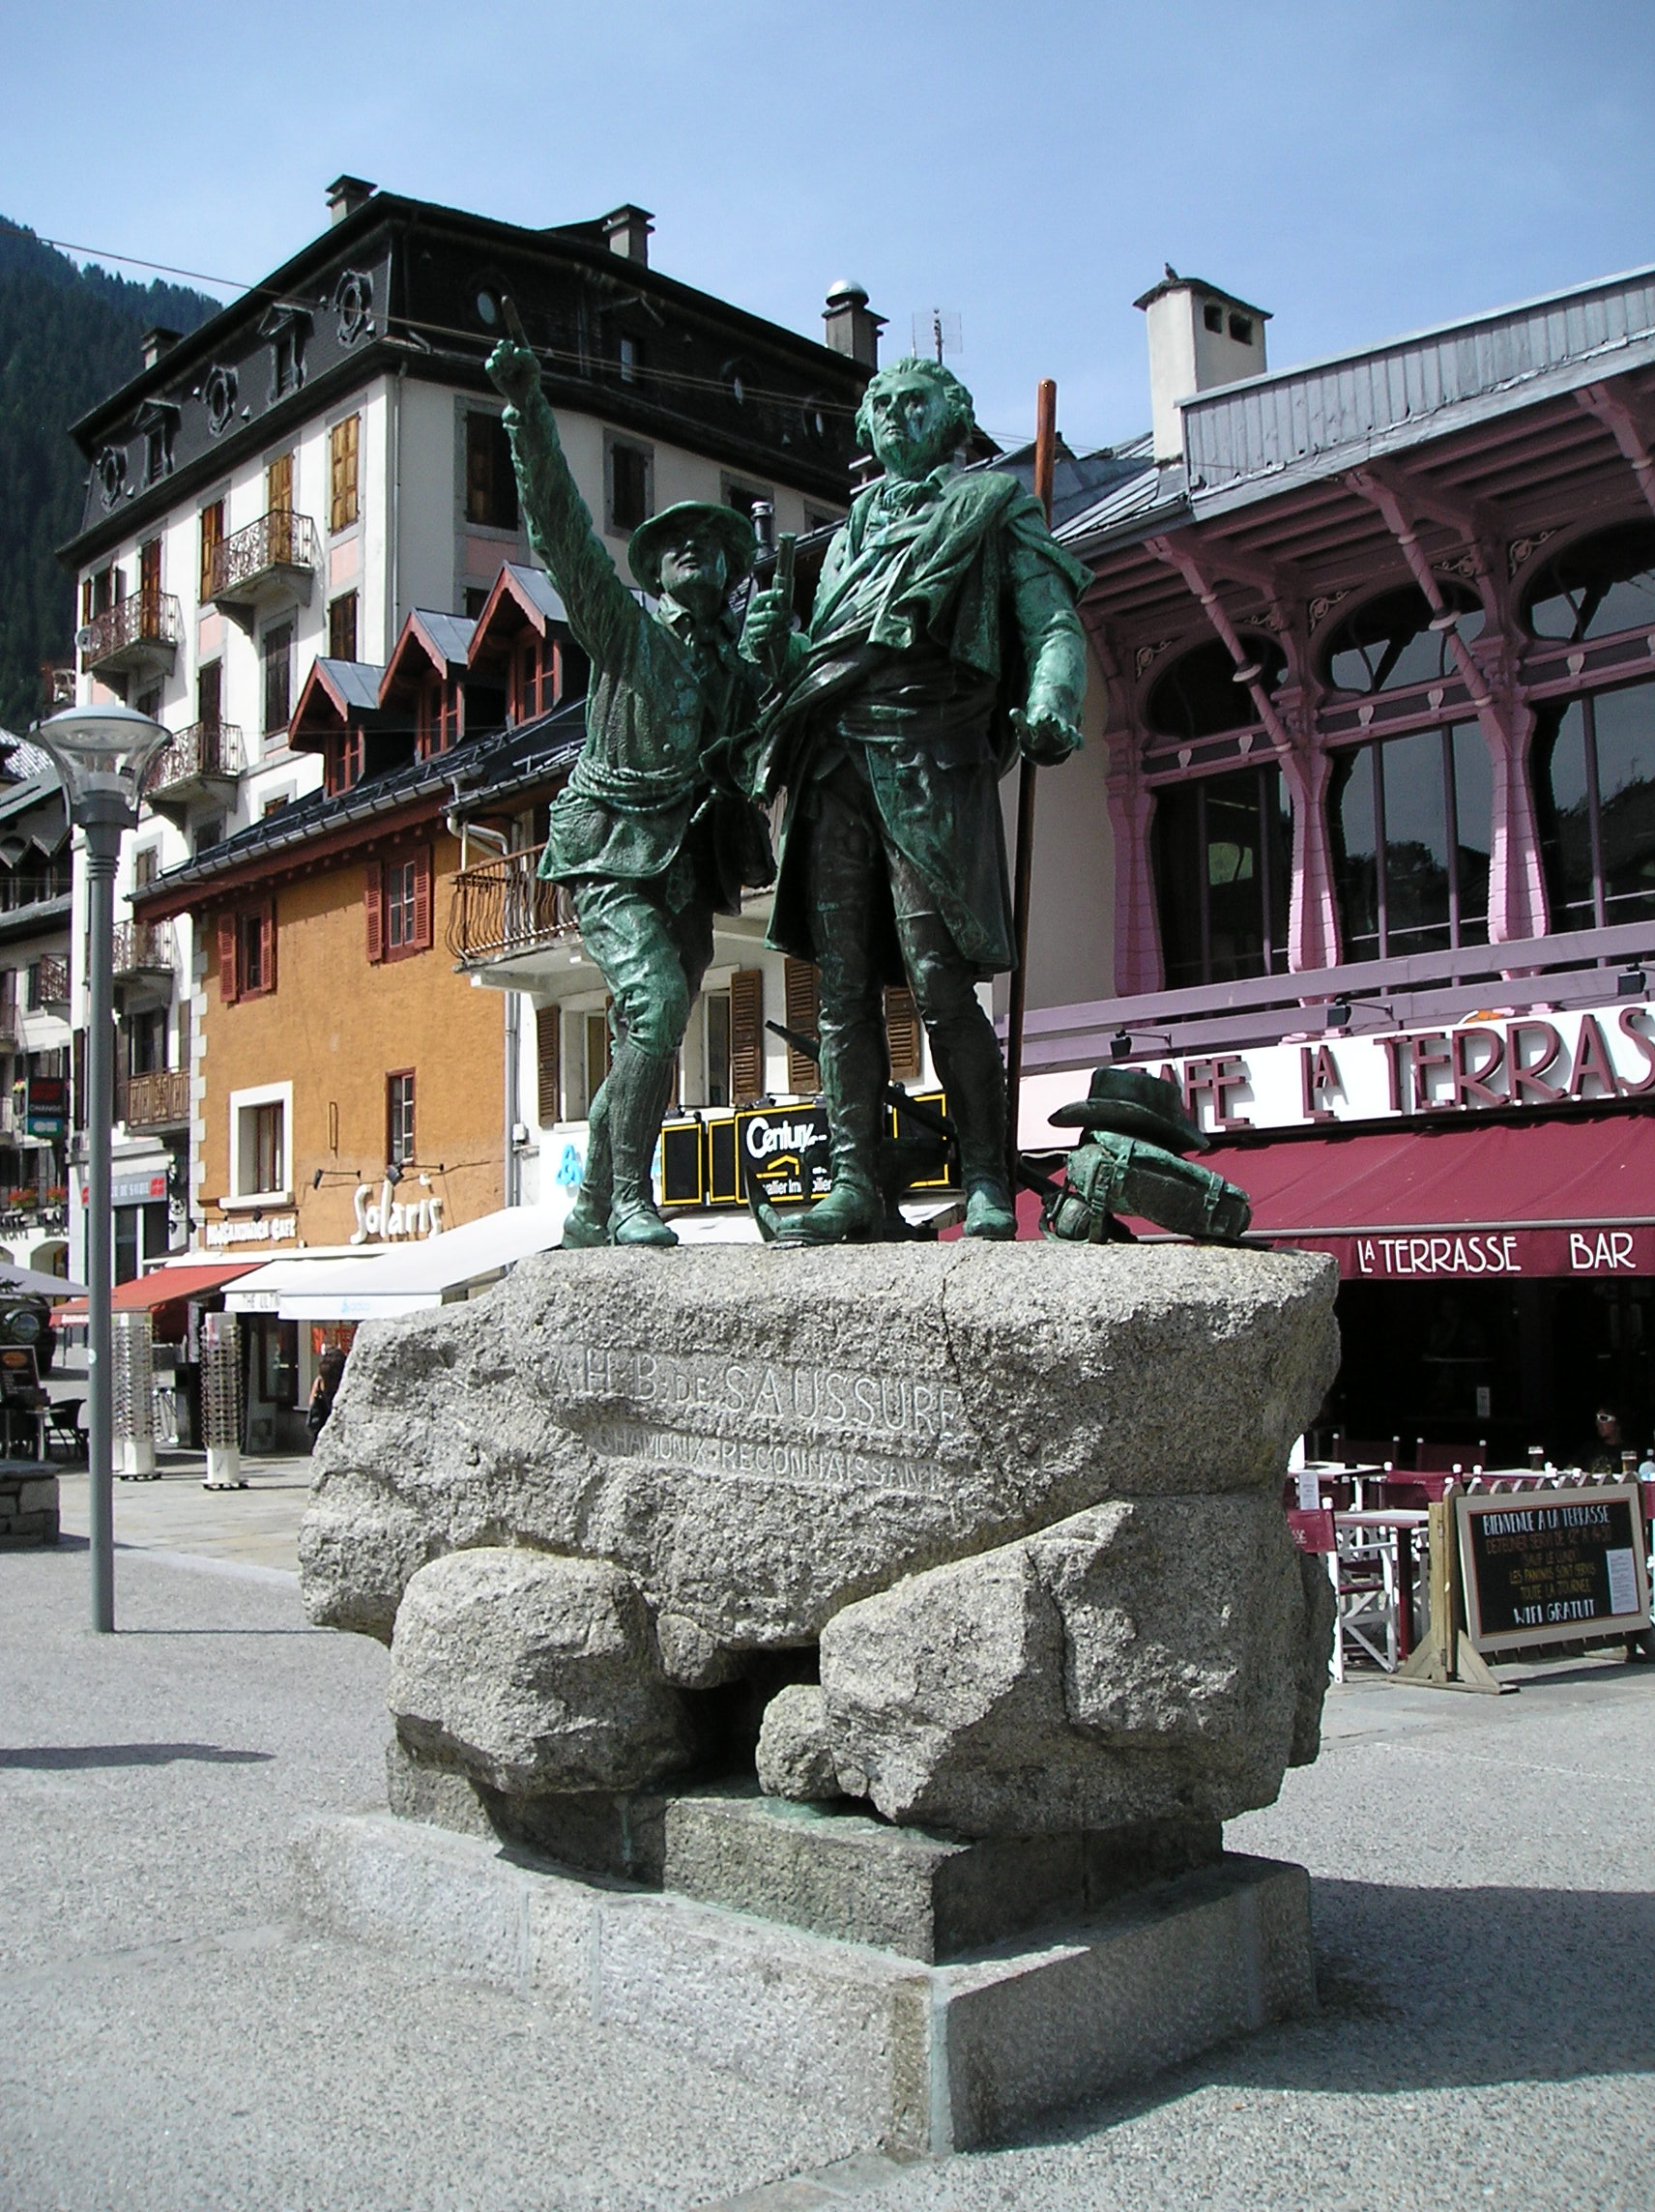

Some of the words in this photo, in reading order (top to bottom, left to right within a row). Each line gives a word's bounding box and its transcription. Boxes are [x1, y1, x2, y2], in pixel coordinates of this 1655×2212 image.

[1125, 1055, 1250, 1127] FE
[1300, 1045, 1340, 1119] LA
[746, 1117, 814, 1158] Century
[350, 1179, 442, 1245] Solaris
[1357, 1239, 1375, 1272] LA
[1379, 1237, 1522, 1272] TERRASSE
[1570, 1233, 1636, 1269] BAR
[725, 1364, 964, 1437] SAUSSURE
[597, 1425, 706, 1464] CHAMONIX
[1483, 1510, 1534, 1536] BIENVENUE
[1548, 1508, 1558, 1528] LA
[1561, 1505, 1611, 1528] TERRASSE
[1513, 1604, 1543, 1624] WIFI
[1547, 1599, 1595, 1621] GRATUIT
